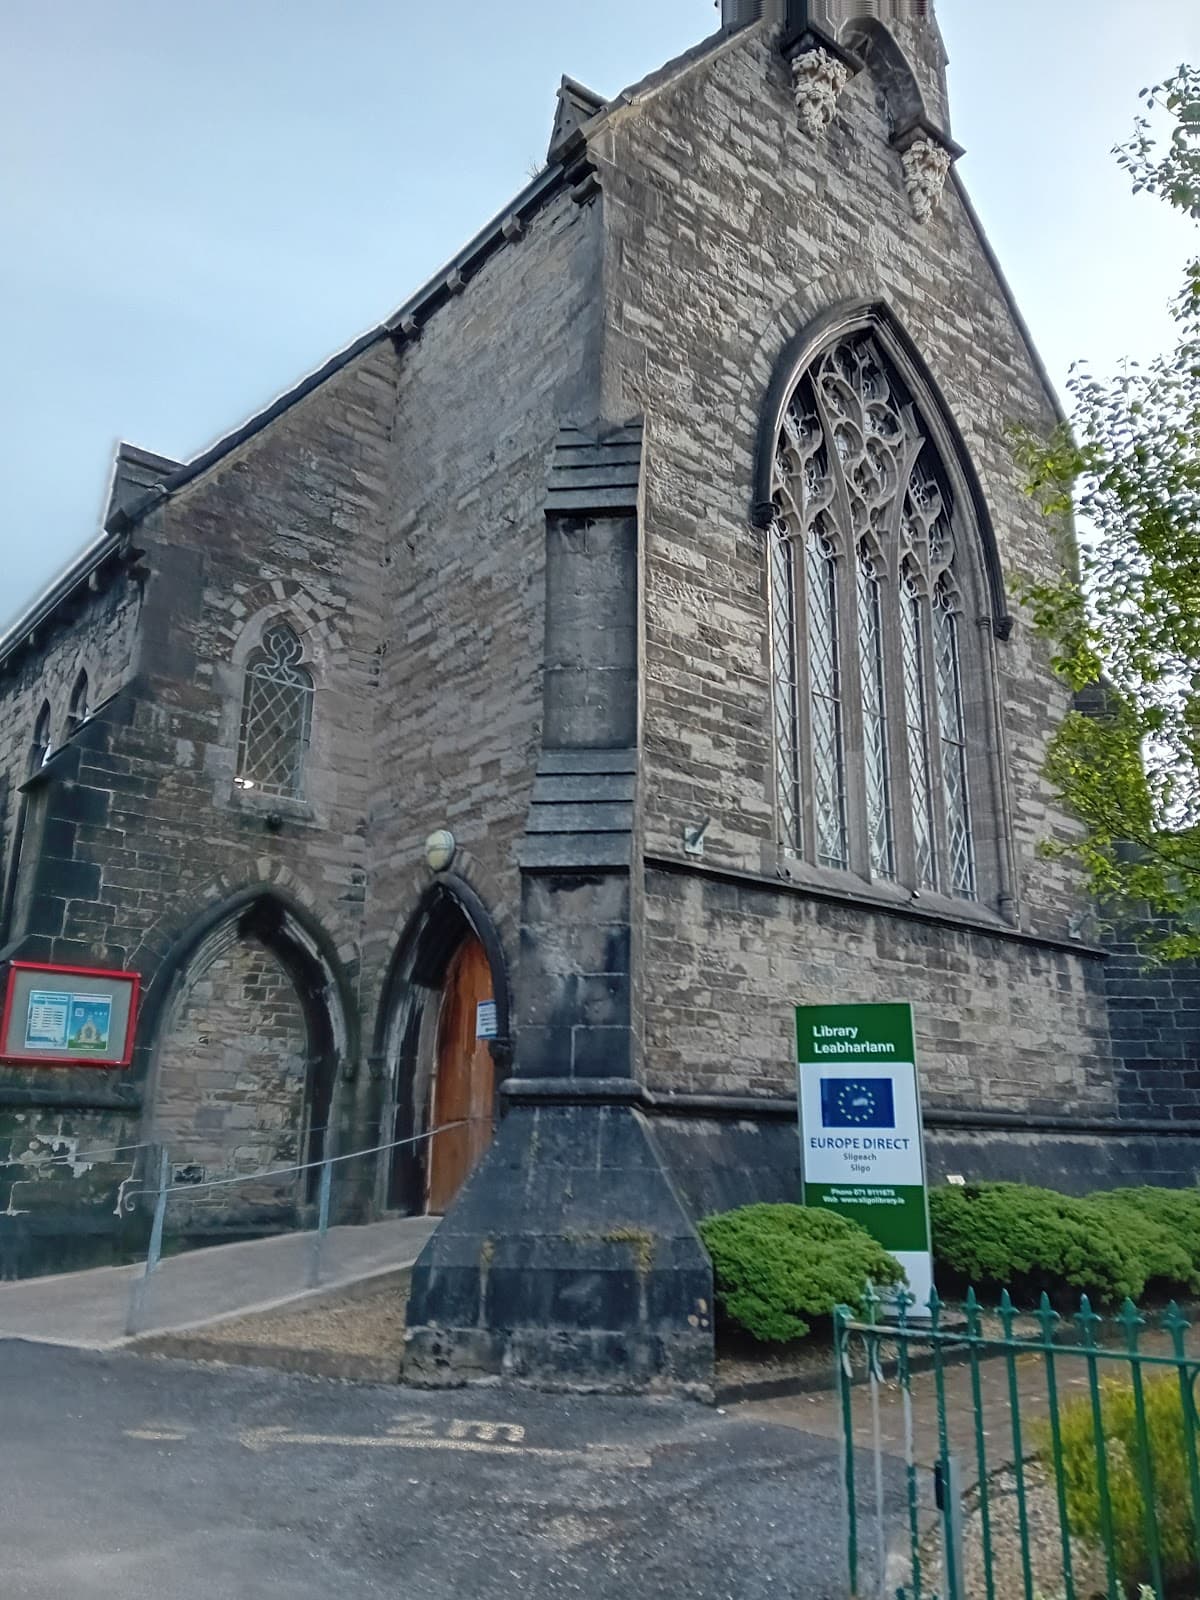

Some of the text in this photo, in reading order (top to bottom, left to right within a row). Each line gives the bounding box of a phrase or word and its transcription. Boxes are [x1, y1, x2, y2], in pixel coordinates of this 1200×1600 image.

[812, 1025, 858, 1039] Library
[813, 1041, 895, 1054] Leabharlann
[810, 1137, 910, 1150] EUROPE DIRECT
[843, 1153, 877, 1162] Sligeach
[850, 1164, 871, 1173] Sligo
